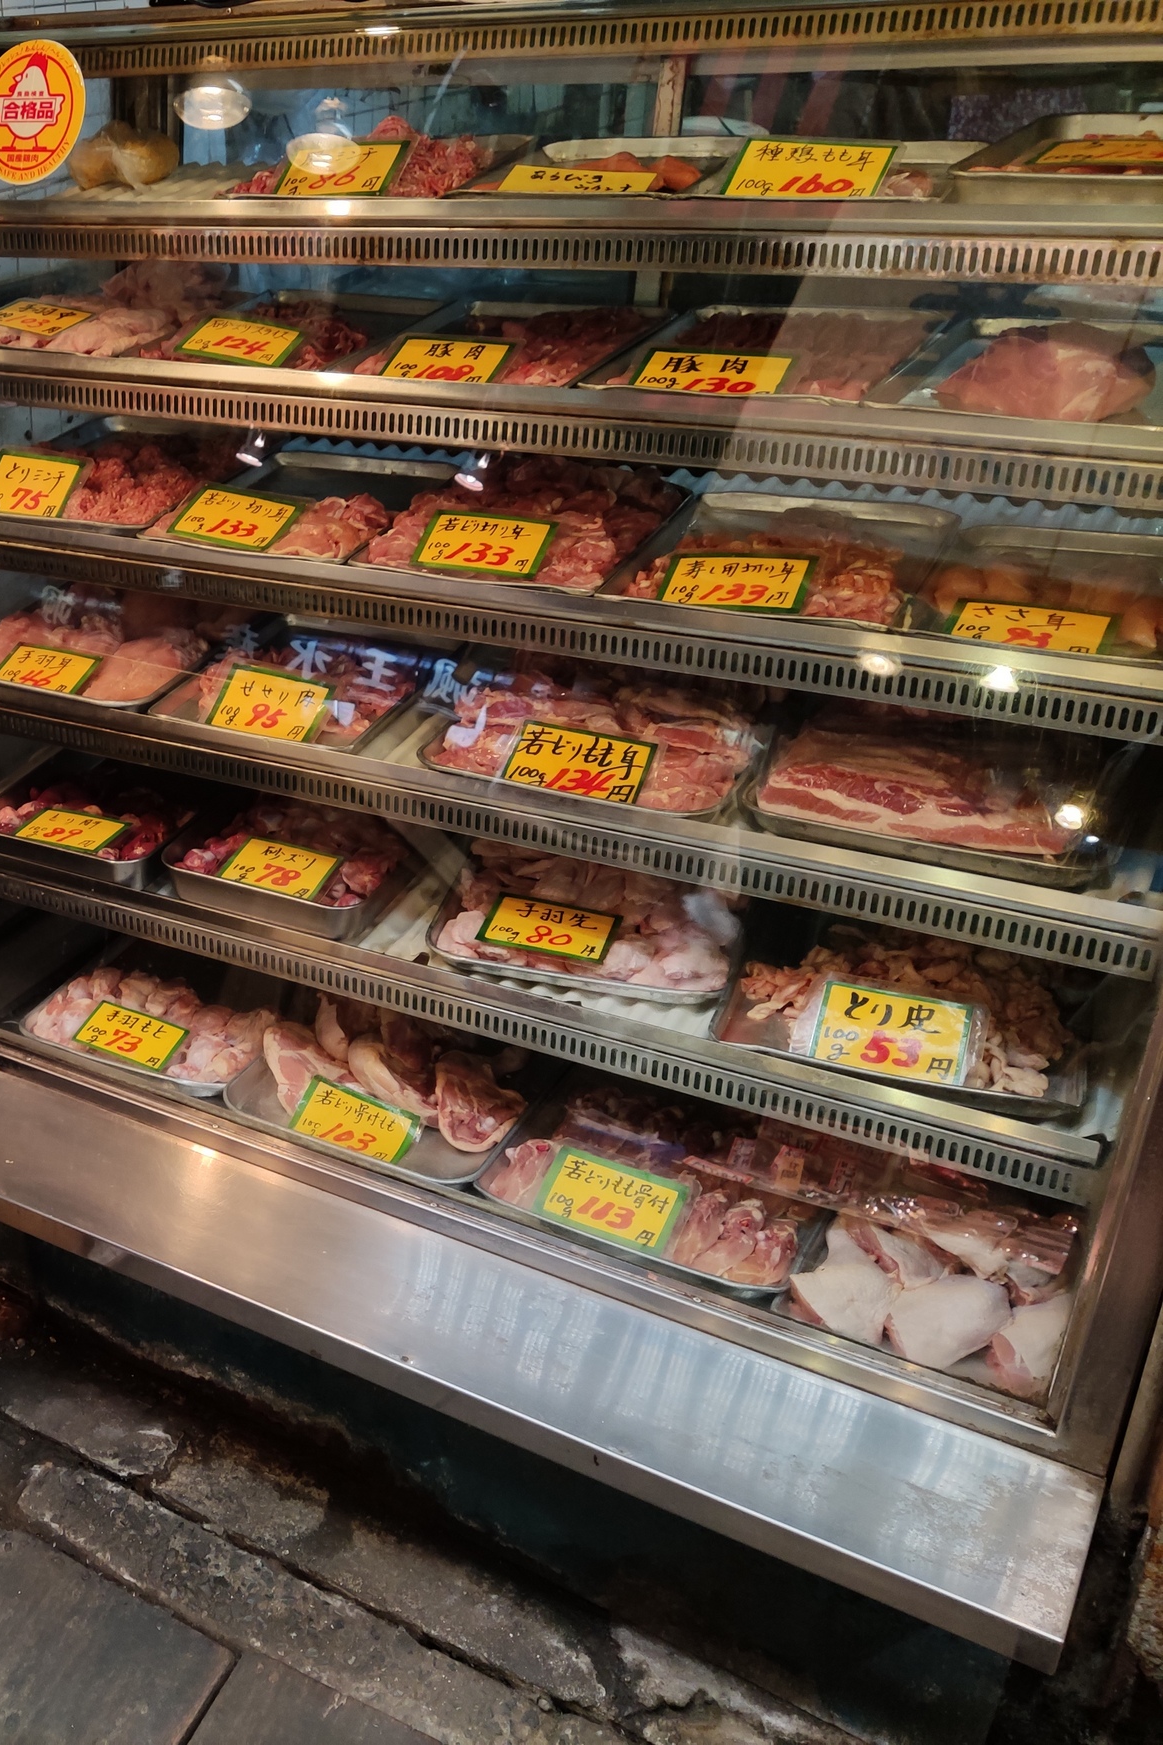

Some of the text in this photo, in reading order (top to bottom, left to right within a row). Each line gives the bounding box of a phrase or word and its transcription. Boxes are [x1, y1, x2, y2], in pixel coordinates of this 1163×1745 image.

[3, 100, 55, 121] 合格品
[16, 170, 36, 182] AND
[35, 138, 72, 180] HEALTHY
[530, 170, 604, 184] あらびき
[735, 178, 774, 197] 100g
[776, 169, 855, 197] 160
[210, 335, 272, 356] 124
[422, 342, 487, 361] 豚肉
[412, 363, 476, 382] 108
[659, 355, 750, 376] 豚肉
[638, 374, 757, 394] 100g 130
[5, 461, 66, 494] とりミンチ
[9, 486, 49, 511] 75
[205, 518, 260, 538] 133
[445, 541, 517, 567] 133
[698, 583, 771, 605] 133
[971, 605, 1077, 633] ささ身
[239, 681, 317, 707] せせり肉
[248, 702, 289, 730] 95
[516, 727, 644, 781] 若どりもも身
[508, 765, 548, 787] 100g
[605, 784, 637, 804] 円
[42, 825, 84, 842] 89
[259, 844, 319, 871] 砂ズリ
[253, 861, 303, 888] 78
[515, 901, 598, 932] 手羽先
[525, 925, 573, 947] 80
[105, 1008, 169, 1040] 手羽もと
[843, 991, 942, 1035] とり皮
[103, 1027, 145, 1053] 73
[859, 1029, 924, 1069] 53
[925, 1057, 955, 1081] 円
[314, 1088, 398, 1134] 若どり骨付もも
[318, 1121, 378, 1152] 103
[563, 1159, 670, 1215] 若どりもも骨付
[577, 1196, 637, 1231] 113
[635, 1229, 656, 1247] 円
